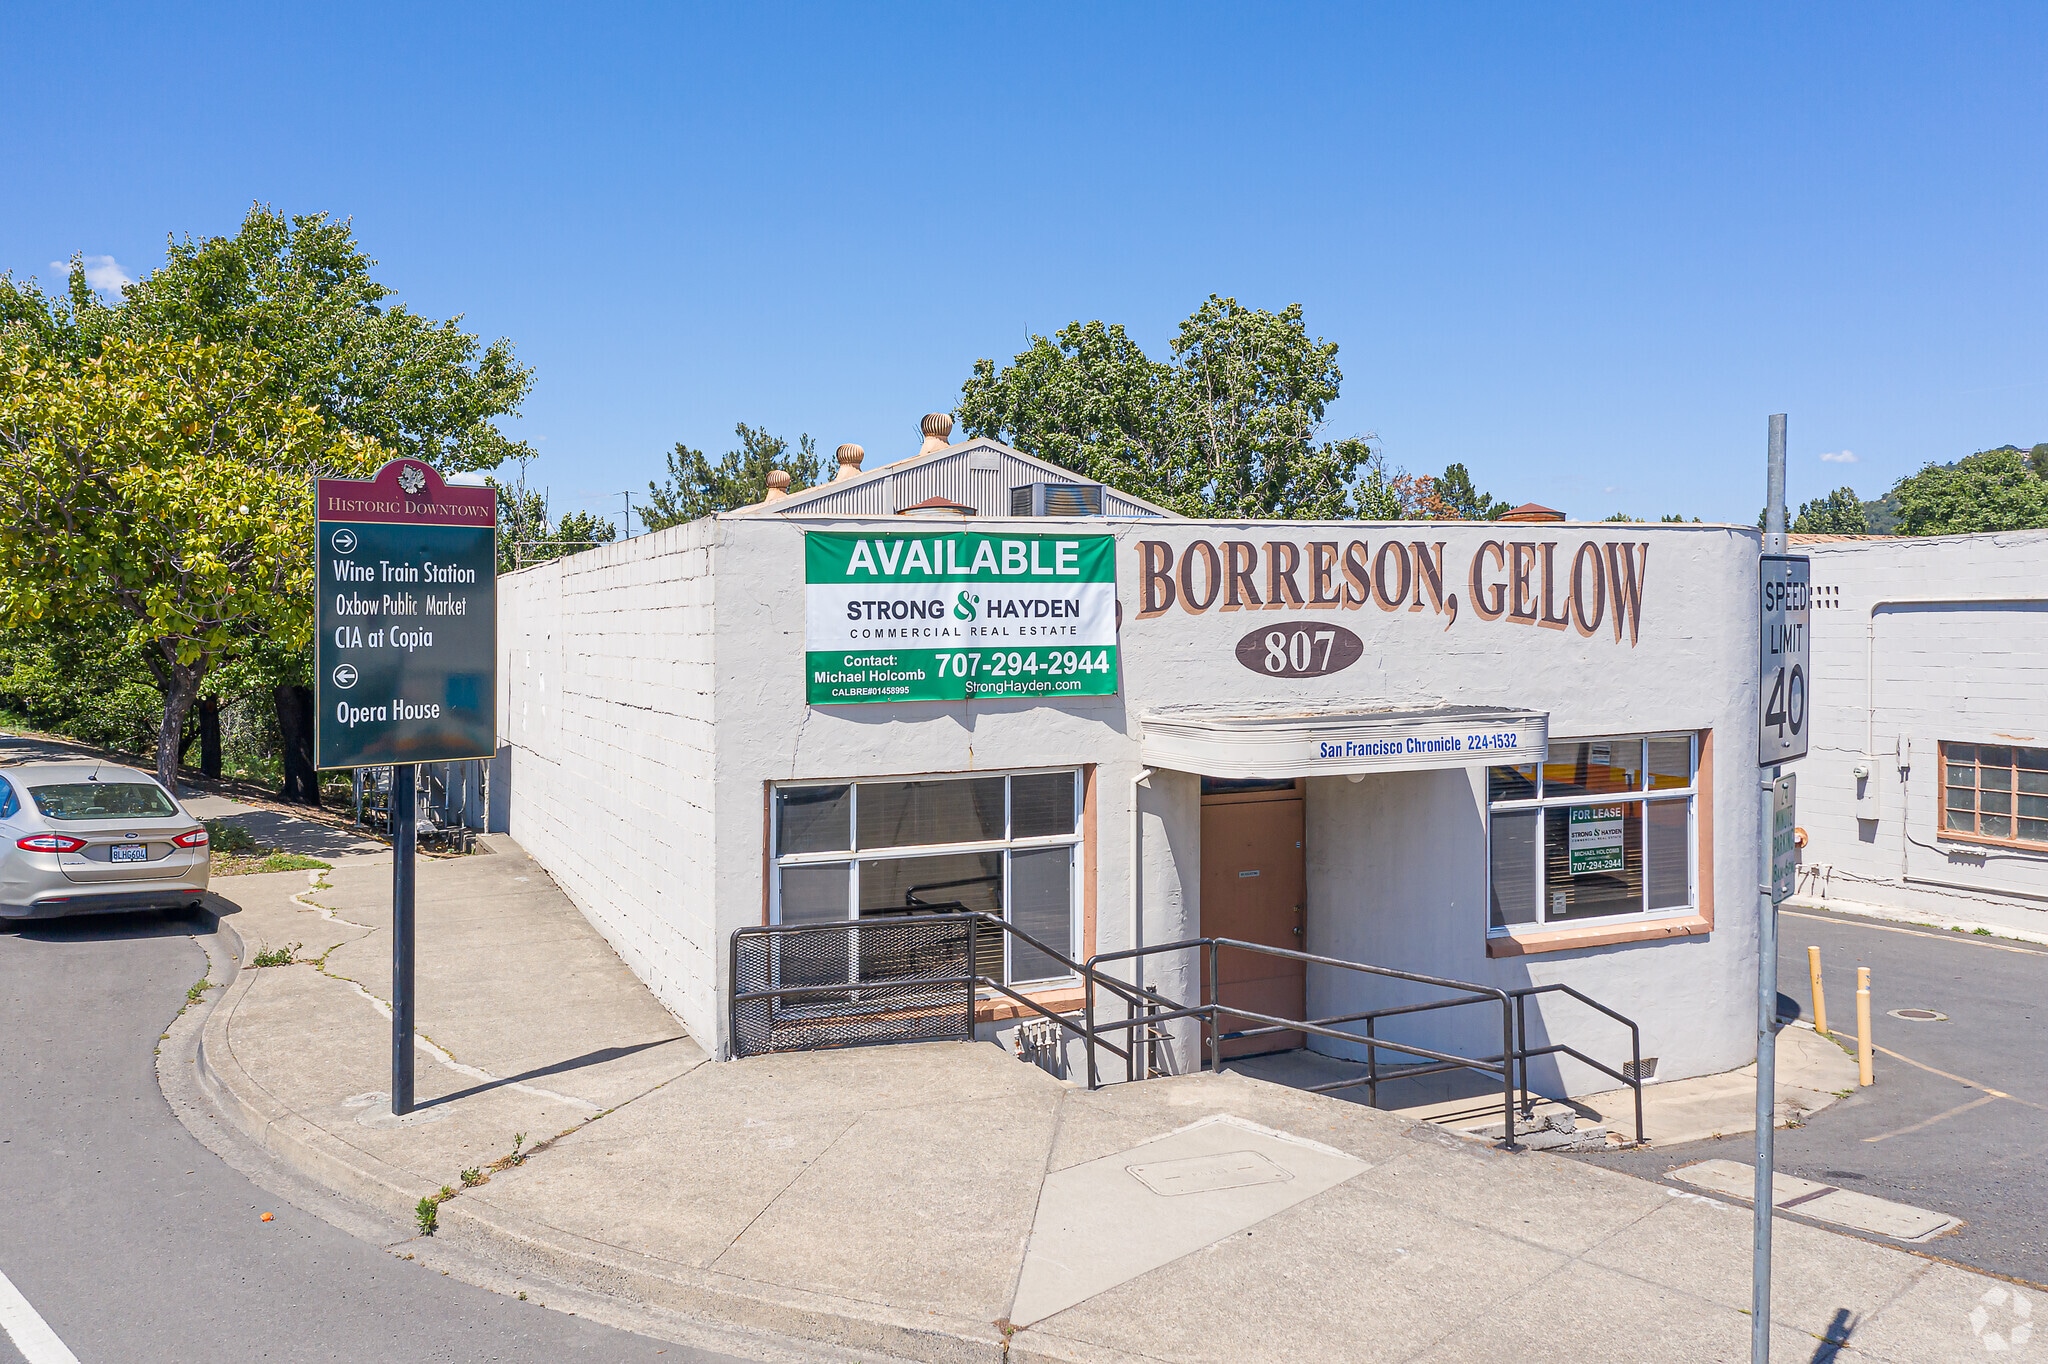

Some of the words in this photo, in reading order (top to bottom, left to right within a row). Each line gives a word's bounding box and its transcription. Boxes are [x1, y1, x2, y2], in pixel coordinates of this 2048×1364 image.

[328, 496, 400, 514] HISTORIC
[405, 500, 489, 517] DOWNTOWN
[845, 539, 1080, 576] AVAILABLE
[333, 559, 375, 582] Wine
[380, 560, 418, 583] Train
[424, 561, 475, 584] Station
[336, 592, 379, 616] Oxbow
[383, 592, 417, 616] Public
[426, 593, 466, 616] Market
[847, 599, 944, 621] STRONG
[953, 590, 980, 622] &
[987, 599, 1080, 618] HAYDEN
[1134, 540, 1458, 632] BORRESON,
[1468, 540, 1650, 649] GELOW
[1765, 581, 1807, 612] SPEED
[335, 626, 363, 649] CIA
[368, 629, 384, 648] at
[390, 626, 433, 652] Copia
[850, 627, 961, 639] COMMERCIAL
[970, 626, 1009, 636] REAL
[1019, 625, 1077, 636] ESTATE
[1771, 623, 1802, 654] LIMIT
[843, 654, 898, 667] Contact:
[935, 650, 1110, 678] 707-294-2944
[1263, 630, 1335, 673] 807
[814, 670, 866, 683] Michael
[869, 668, 926, 682] Holcomb
[965, 679, 1081, 694] StrongHayden.com
[831, 686, 910, 697] CALBRE#01458995
[1765, 663, 1804, 739] 40
[336, 701, 387, 728] Opera
[393, 699, 440, 721] House
[1320, 741, 1343, 758] San
[1346, 739, 1402, 756] Francisco
[1406, 736, 1461, 753] Chronicle
[1468, 733, 1517, 750] 224-1532
[1572, 810, 1591, 820] FOR
[1592, 808, 1621, 819] LEASE
[1601, 828, 1622, 836] HAYDEN
[1573, 859, 1621, 871] 707-294-2944
